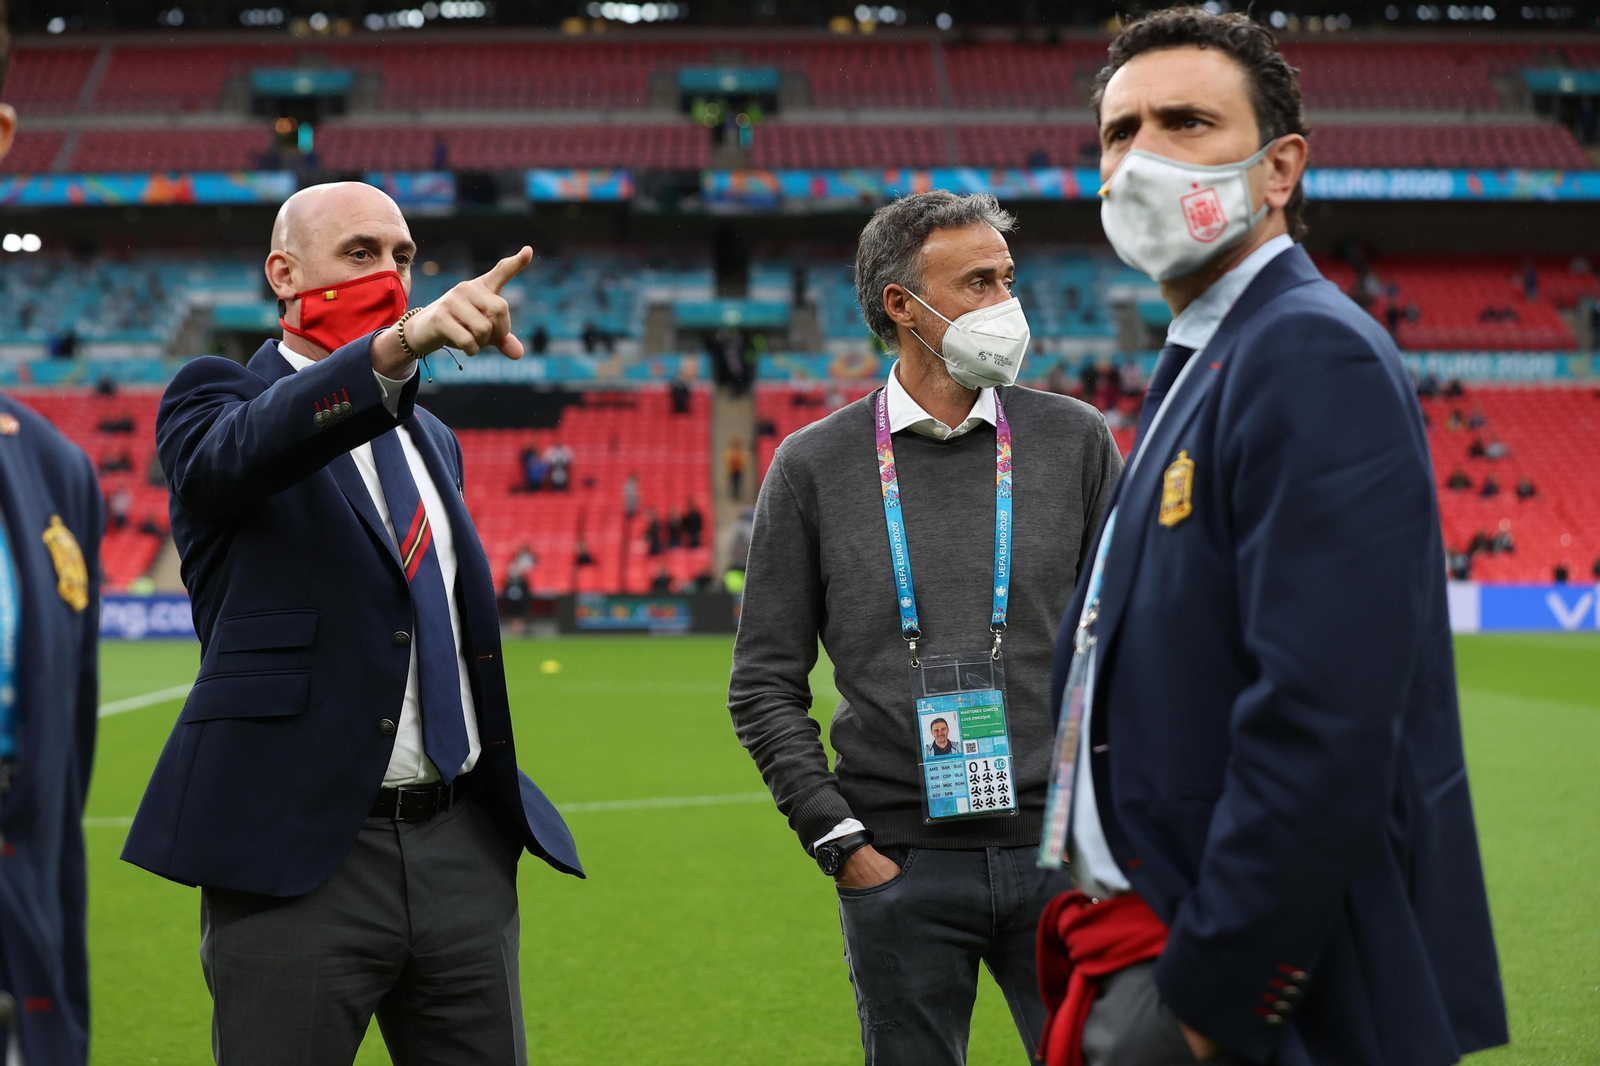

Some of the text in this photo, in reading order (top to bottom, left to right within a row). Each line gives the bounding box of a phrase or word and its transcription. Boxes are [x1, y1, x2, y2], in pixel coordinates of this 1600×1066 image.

[891, 521, 908, 589] UEFA EURO 2020
[998, 510, 1008, 578] UEFA EURO 2020
[968, 759, 1005, 773] 0 1 10
